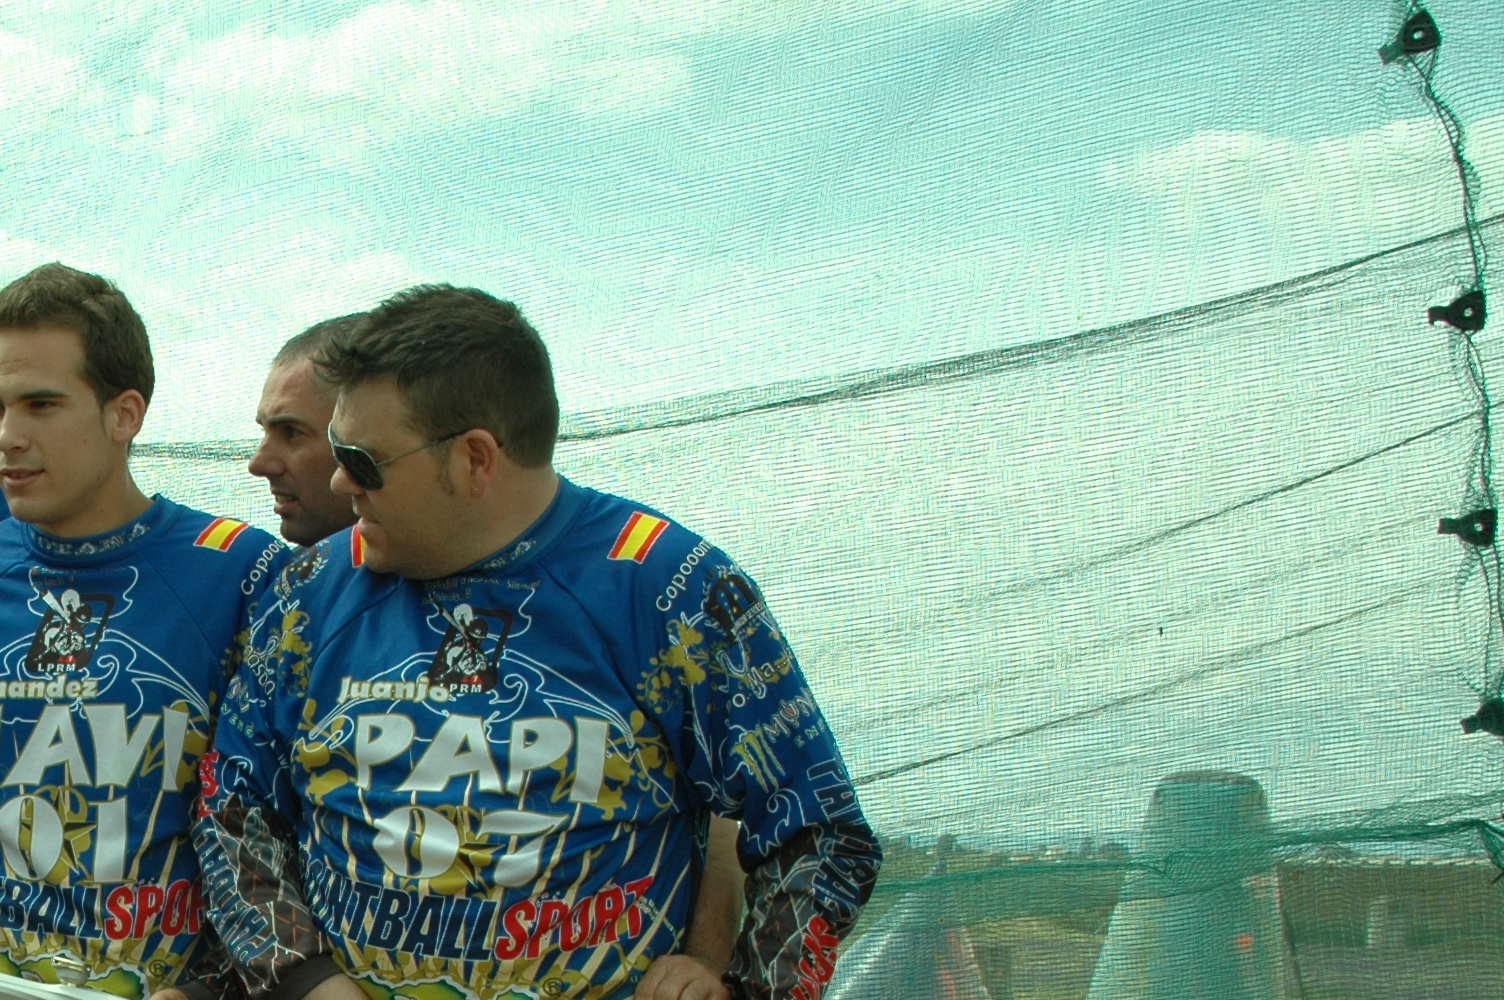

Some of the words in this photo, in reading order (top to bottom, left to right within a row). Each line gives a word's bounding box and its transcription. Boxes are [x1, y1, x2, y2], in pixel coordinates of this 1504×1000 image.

[37, 662, 76, 673] LPRM
[338, 676, 449, 704] Juanjo
[354, 711, 610, 804] PAPI
[371, 804, 569, 889] 07
[496, 875, 655, 961] SPORT
